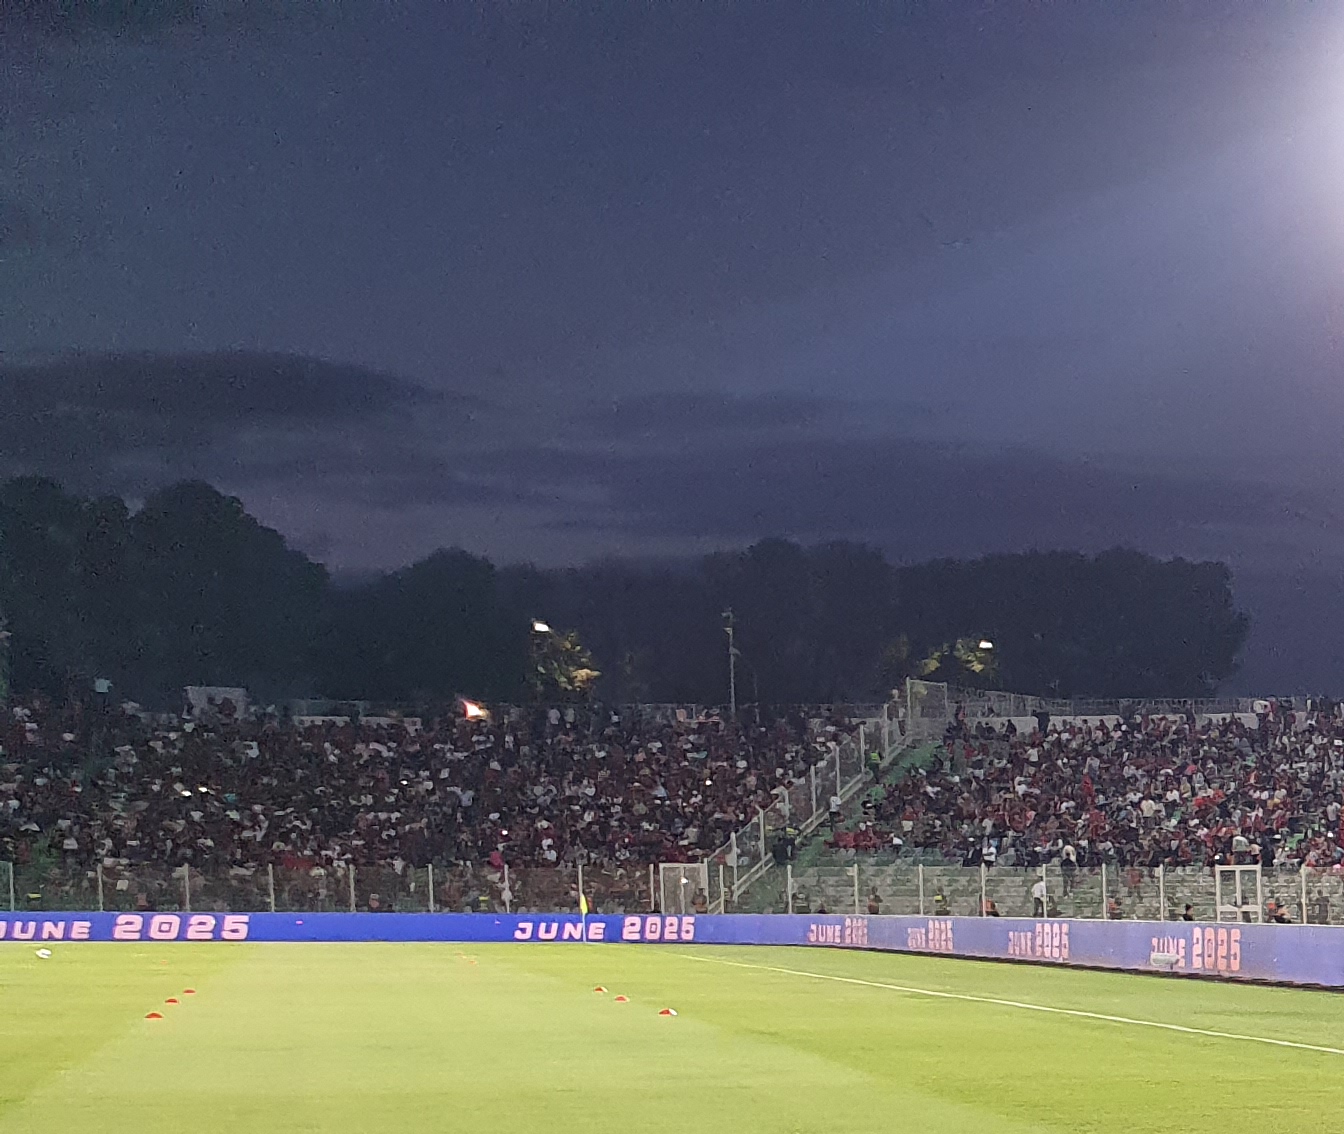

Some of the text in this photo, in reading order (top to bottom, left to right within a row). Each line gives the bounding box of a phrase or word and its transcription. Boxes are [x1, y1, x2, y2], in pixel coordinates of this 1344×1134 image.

[113, 914, 250, 940] 2025
[514, 916, 695, 941] JUNE 2025
[810, 924, 842, 944] JUNE
[1035, 923, 1069, 960] 2025
[1192, 927, 1241, 971] 2025
